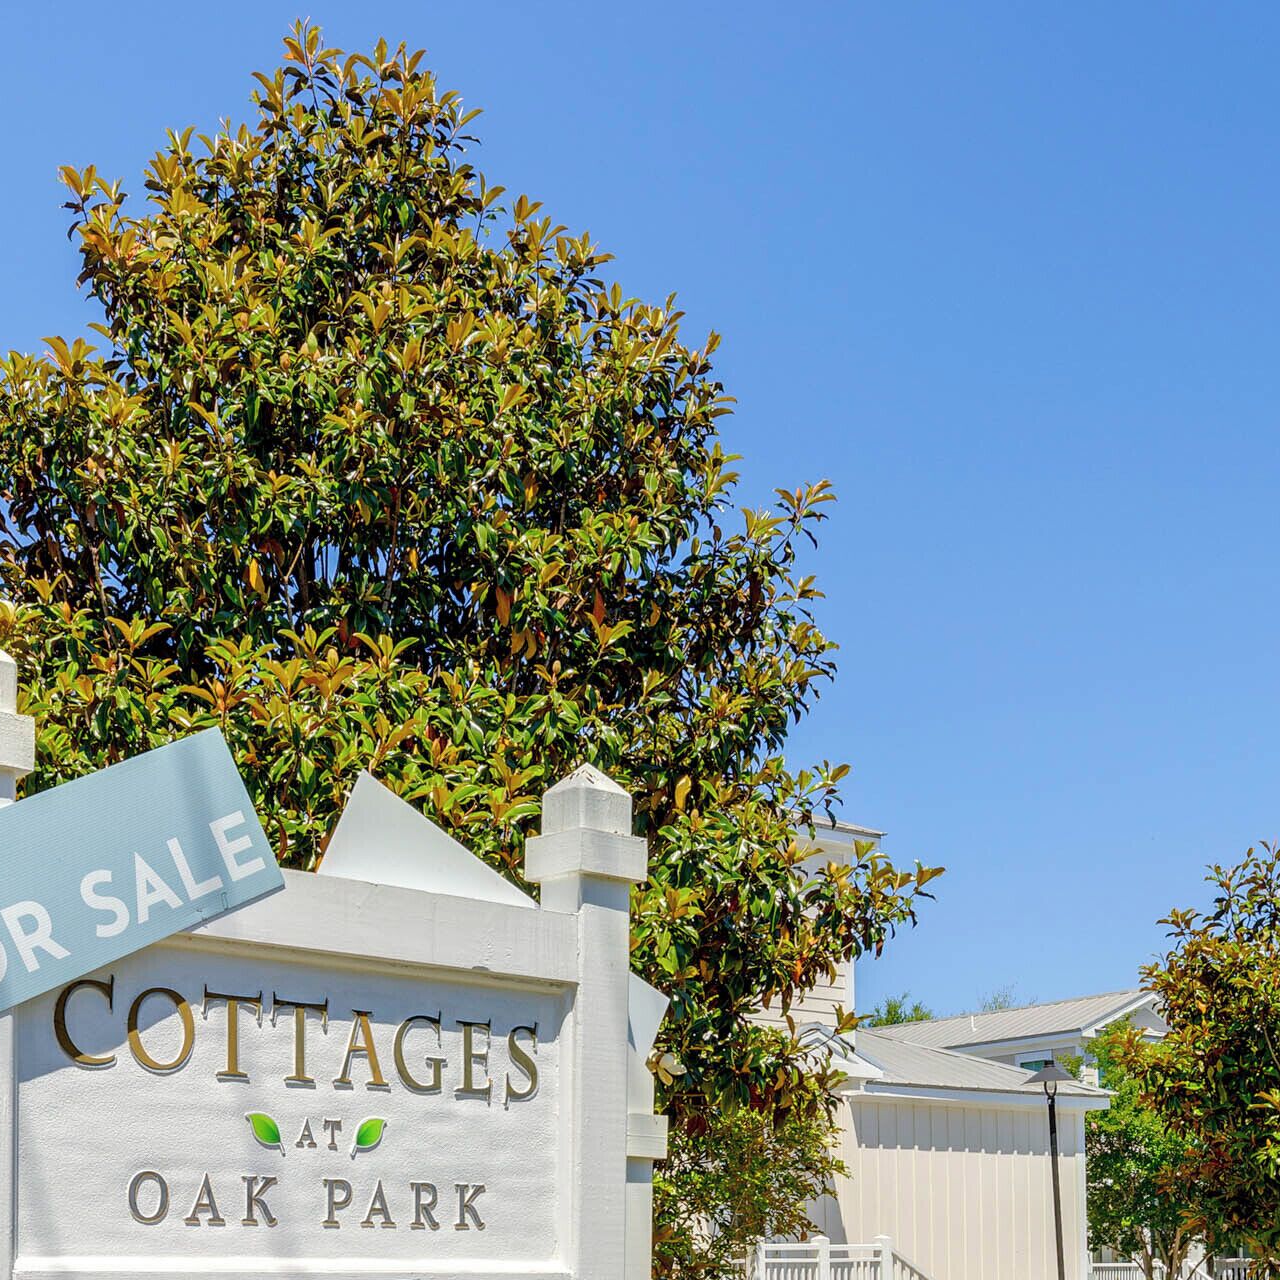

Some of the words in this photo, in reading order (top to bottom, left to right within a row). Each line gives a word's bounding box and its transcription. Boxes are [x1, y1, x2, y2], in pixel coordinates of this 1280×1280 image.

[79, 810, 266, 939] SALE
[53, 974, 540, 1109] COTTAGES
[295, 1117, 342, 1151] AT
[126, 1169, 279, 1227] OAK
[322, 1177, 487, 1231] PARK
